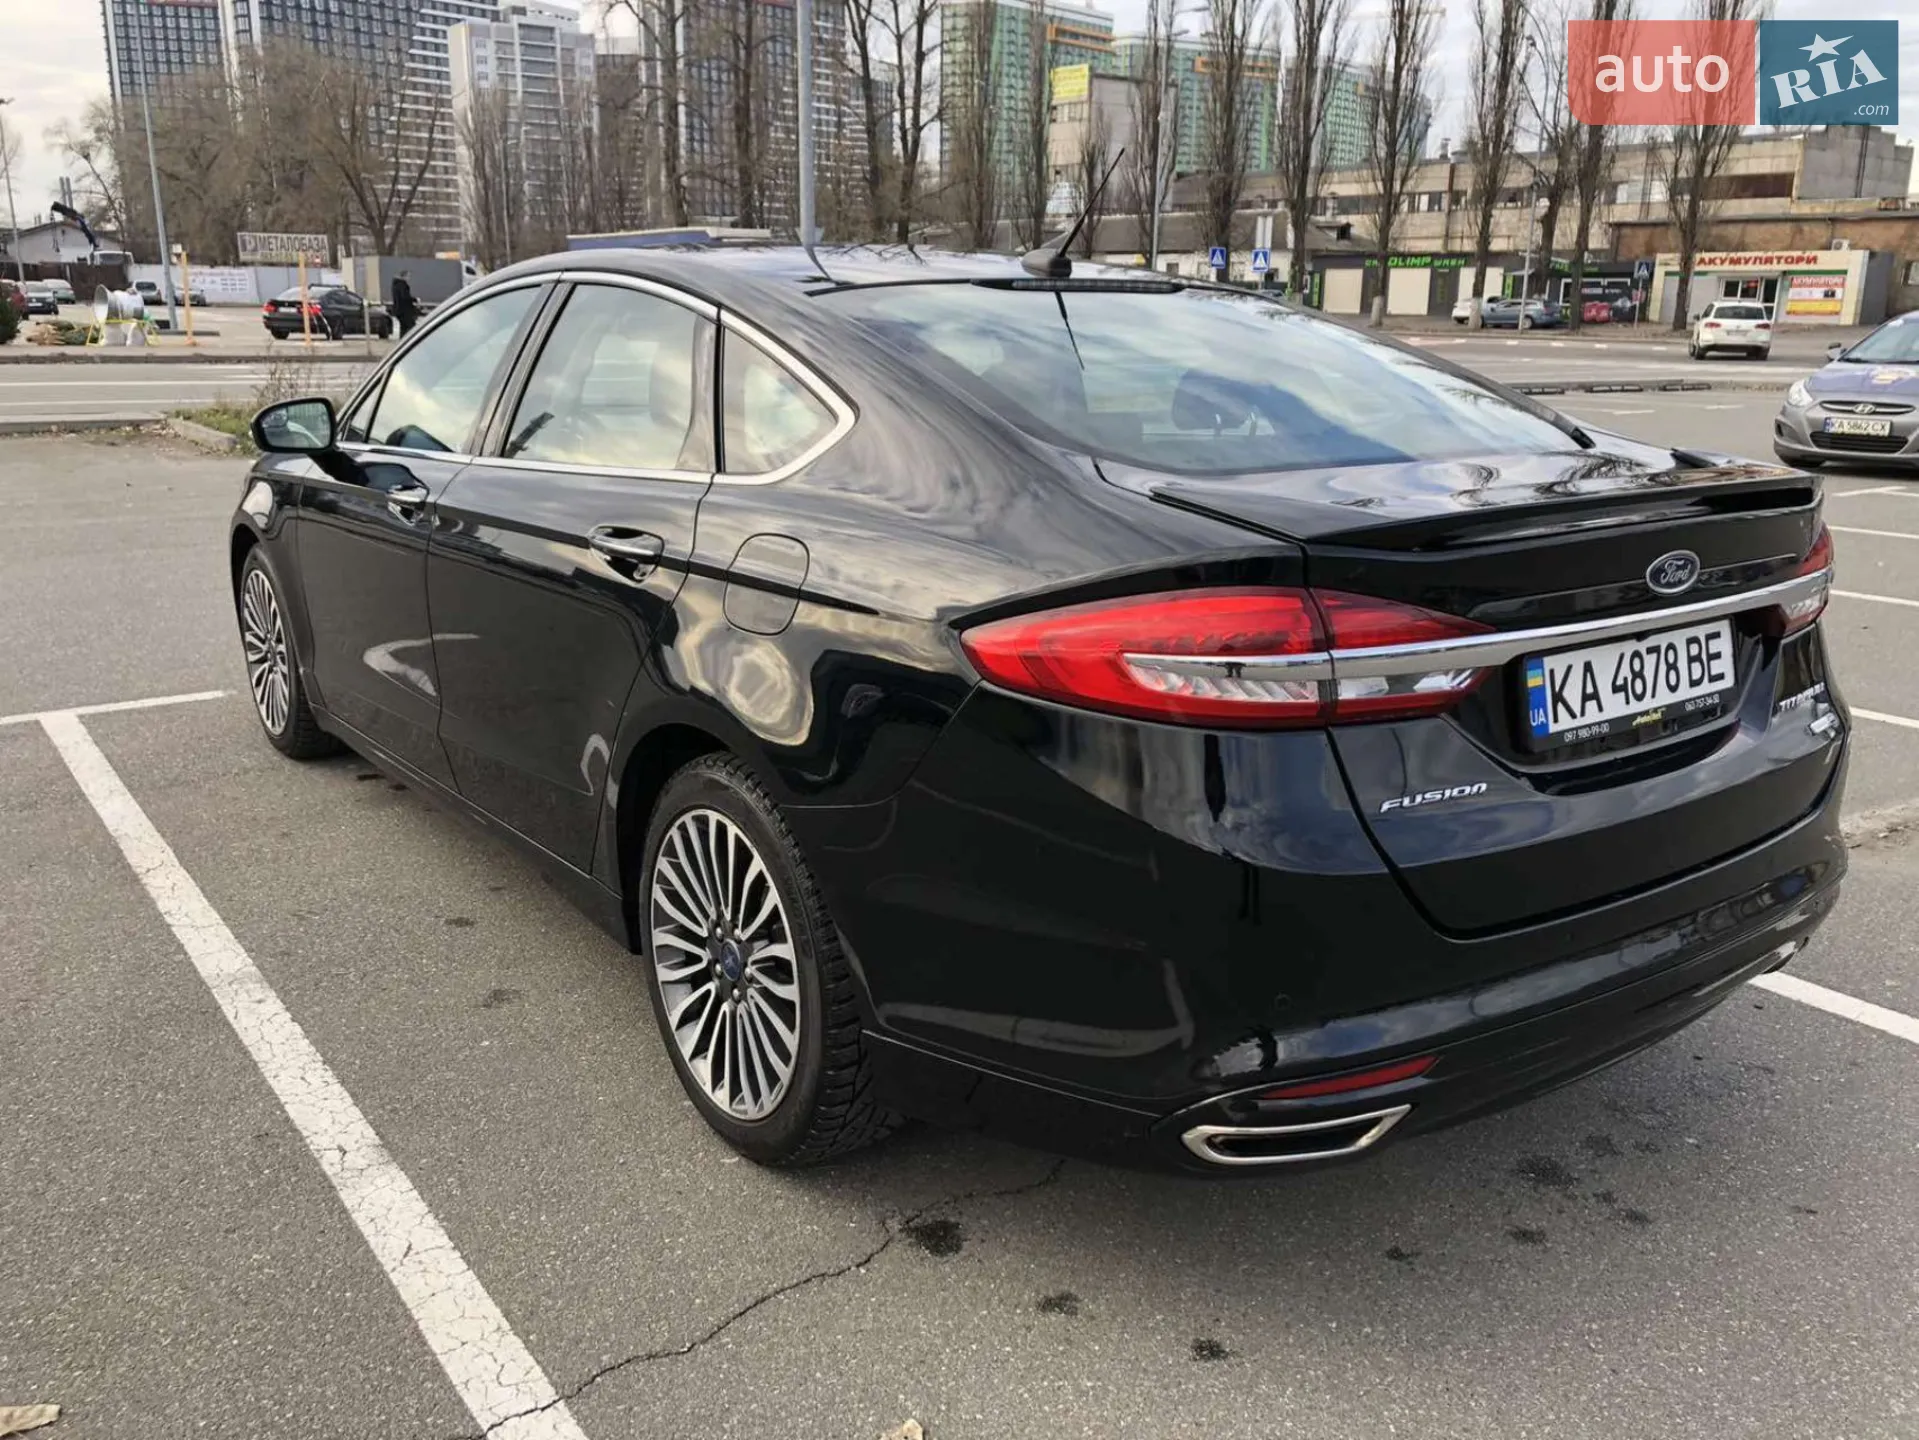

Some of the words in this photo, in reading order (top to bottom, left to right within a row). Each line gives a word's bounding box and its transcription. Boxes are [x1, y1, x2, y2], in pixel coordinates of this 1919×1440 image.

[259, 235, 328, 252] МЕТАЛОБАЗА
[1387, 256, 1432, 267] OLIMP
[1697, 255, 1818, 266] АКУМУЛЯТОРИ
[1871, 422, 1887, 432] CX
[1660, 560, 1691, 584] Ford
[1549, 660, 1604, 724] KA
[1611, 641, 1681, 705] 4878
[1686, 631, 1725, 689] BE
[1530, 709, 1546, 726] UA
[1380, 783, 1487, 813] FUSION
